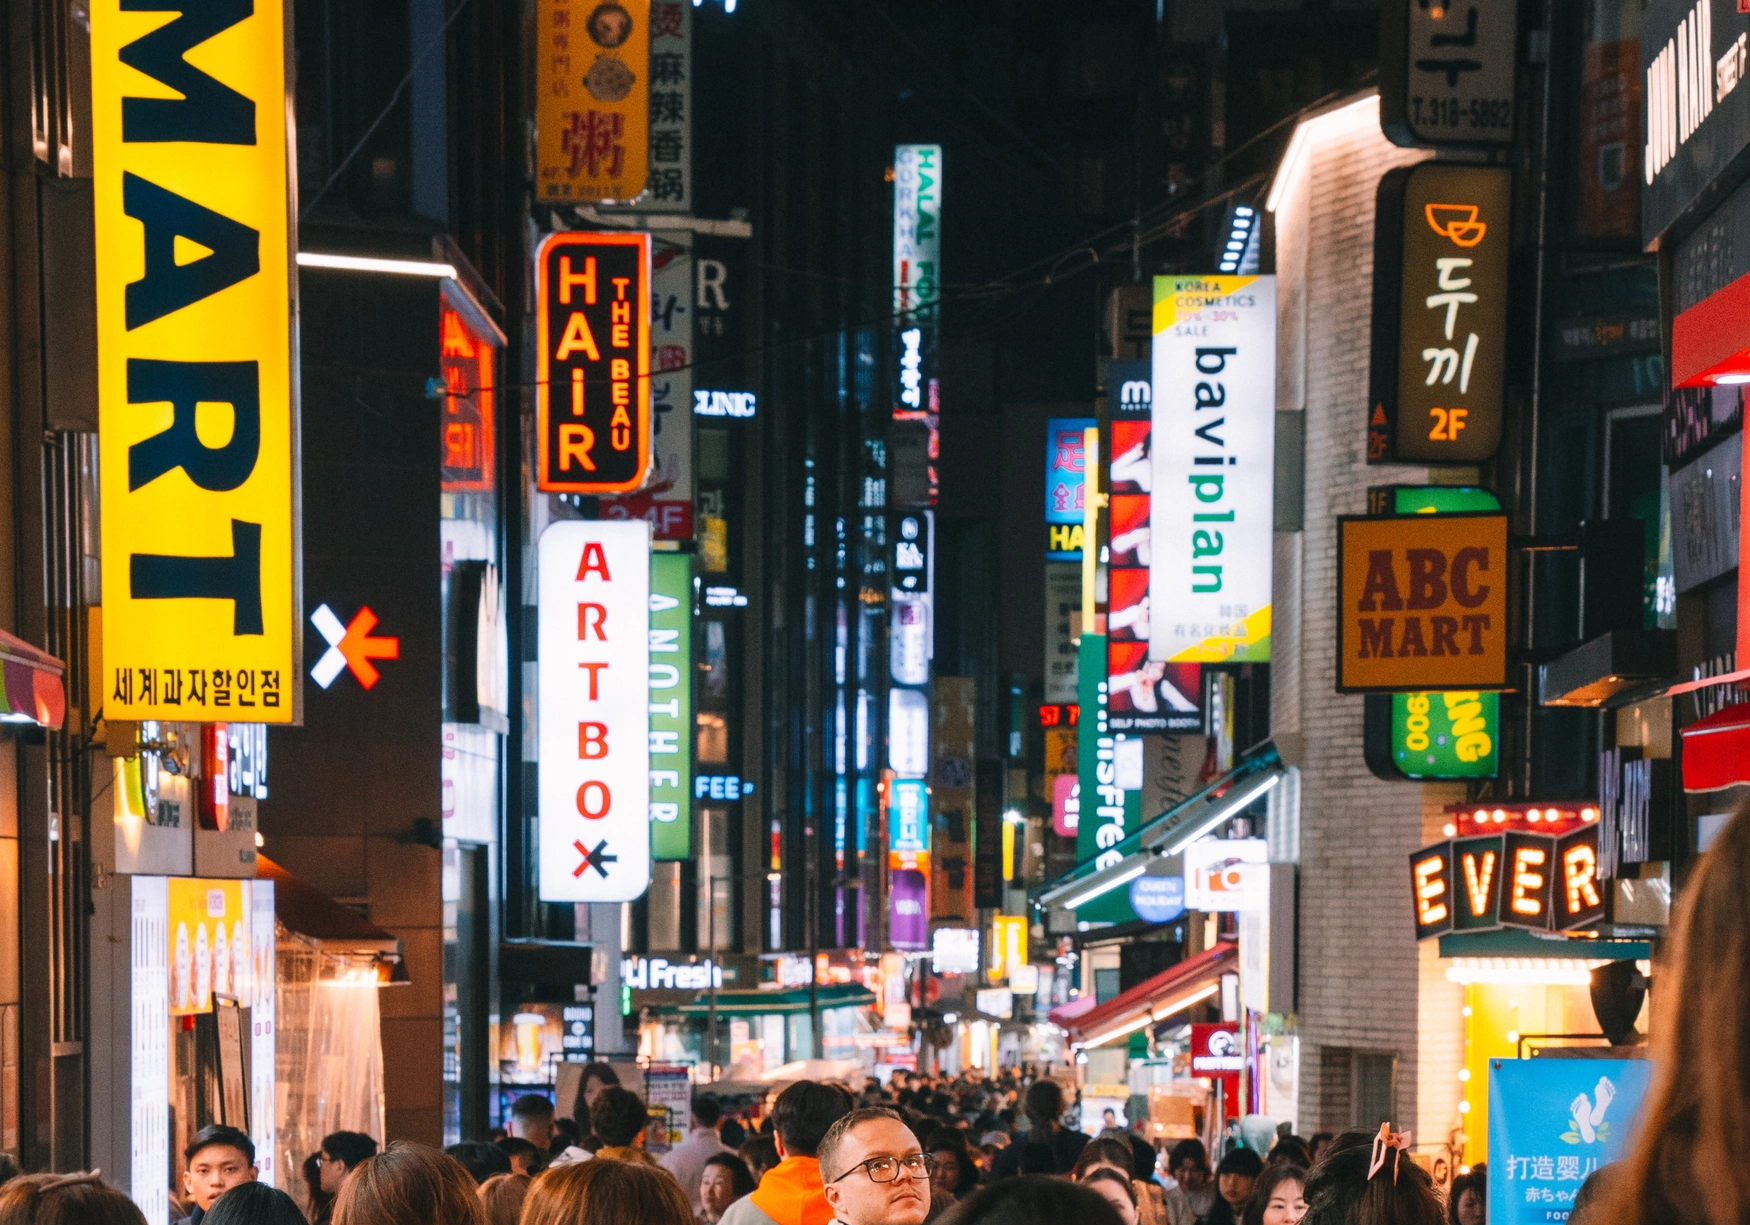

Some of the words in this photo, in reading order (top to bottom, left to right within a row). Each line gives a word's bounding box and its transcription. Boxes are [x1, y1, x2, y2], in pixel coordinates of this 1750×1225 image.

[917, 149, 934, 246] HALAL
[118, 0, 265, 636] MART
[611, 277, 631, 348] THE
[1175, 281, 1221, 292] KOREA
[1175, 295, 1256, 307] COSMETICS
[1175, 325, 1208, 336] SALE
[1422, 257, 1480, 394] 두끼
[556, 255, 601, 472] HAIR
[611, 358, 631, 451] BEAU
[1429, 408, 1468, 440] 2F
[1188, 347, 1238, 593] baviplan
[1358, 546, 1491, 613] ABC
[1358, 614, 1491, 659] MART
[113, 667, 280, 707] 세계과자할인점
[649, 593, 680, 823] ANOTHER
[1109, 717, 1134, 729] SELF
[1134, 717, 1167, 729] PHOTO
[1167, 717, 1200, 729] BOOTH
[1406, 692, 1430, 751] 900
[1413, 844, 1600, 926] EVER
[1506, 1154, 1600, 1181] 打造婴儿
